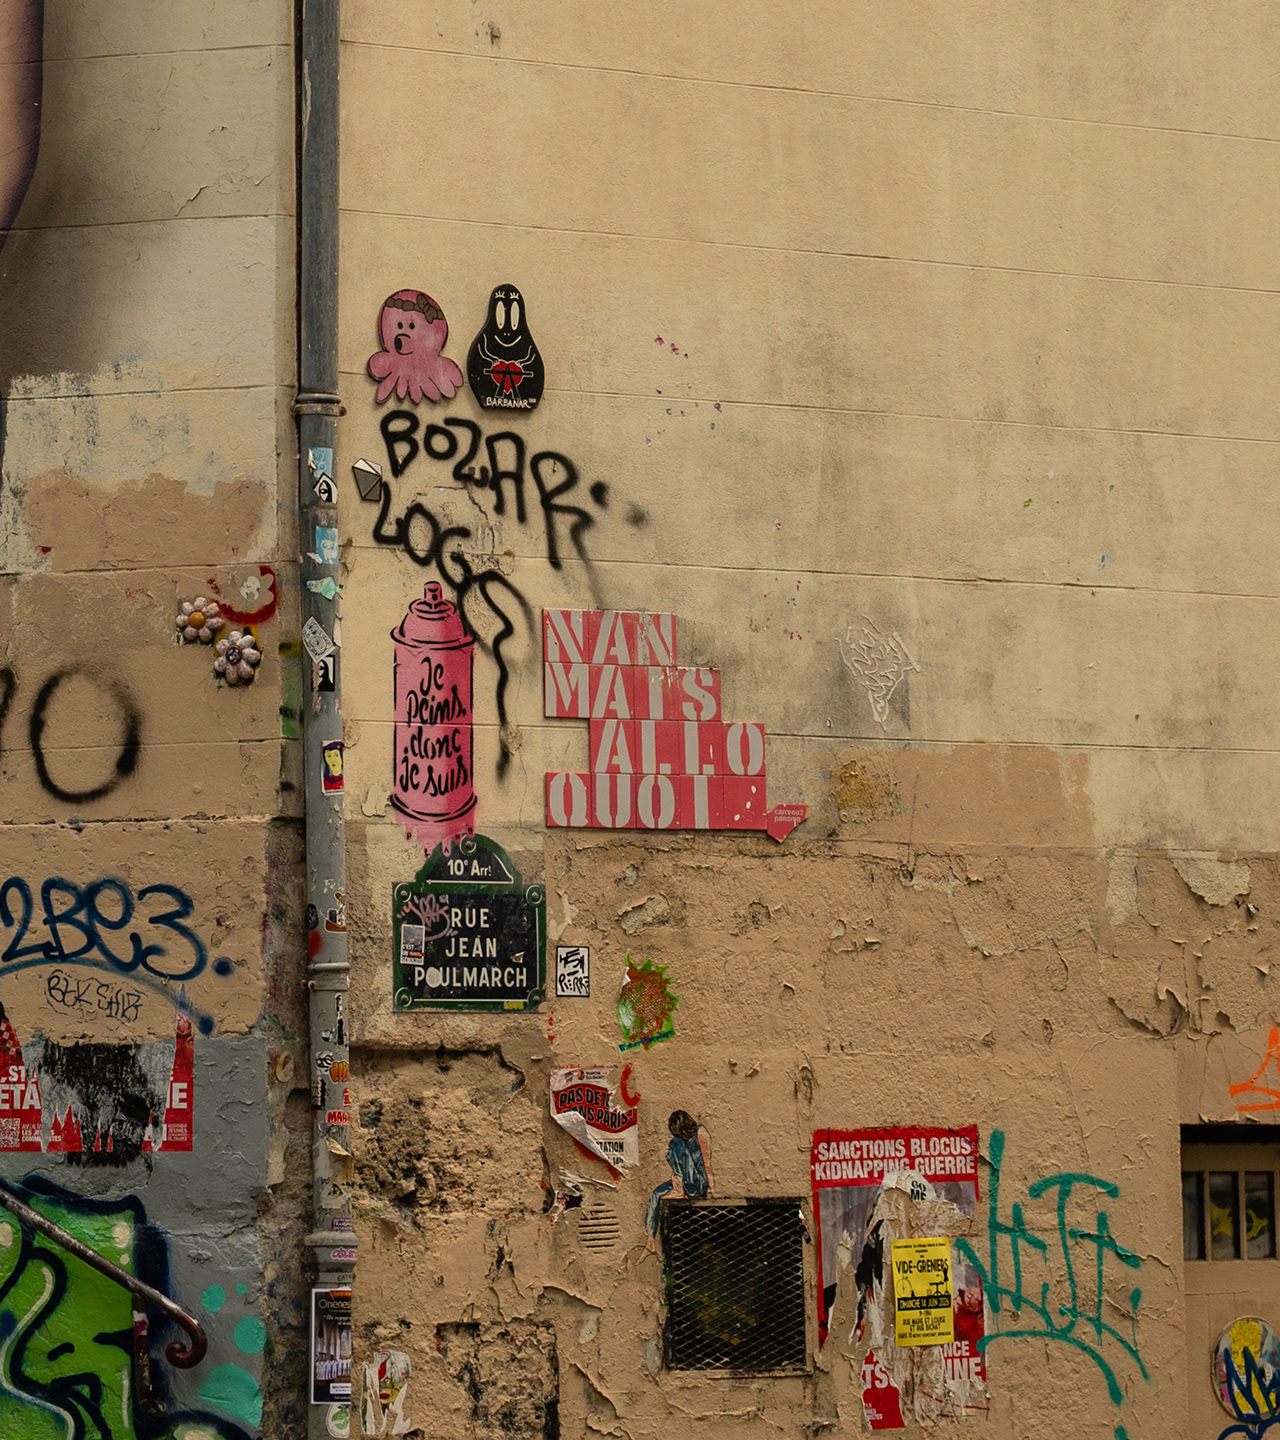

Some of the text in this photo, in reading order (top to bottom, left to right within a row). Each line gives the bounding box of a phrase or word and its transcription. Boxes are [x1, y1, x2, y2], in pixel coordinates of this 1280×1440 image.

[485, 396, 531, 409] BARBANAR
[547, 609, 676, 665] NAN
[545, 663, 718, 722] MAIS
[594, 719, 764, 776] ALLO
[549, 773, 710, 829] QUOI
[451, 907, 490, 928] RUE
[445, 937, 497, 958] JEAN
[414, 966, 527, 988] PULMARCH
[559, 1087, 583, 1107] PAS
[586, 1088, 600, 1106] DE
[596, 1141, 624, 1153] TATION
[818, 1136, 971, 1161] SANCTIONS BLOCUS
[814, 1155, 975, 1181] KIDNAPPING GUERRE
[895, 1258, 949, 1274] VIDE-GRENIERS
